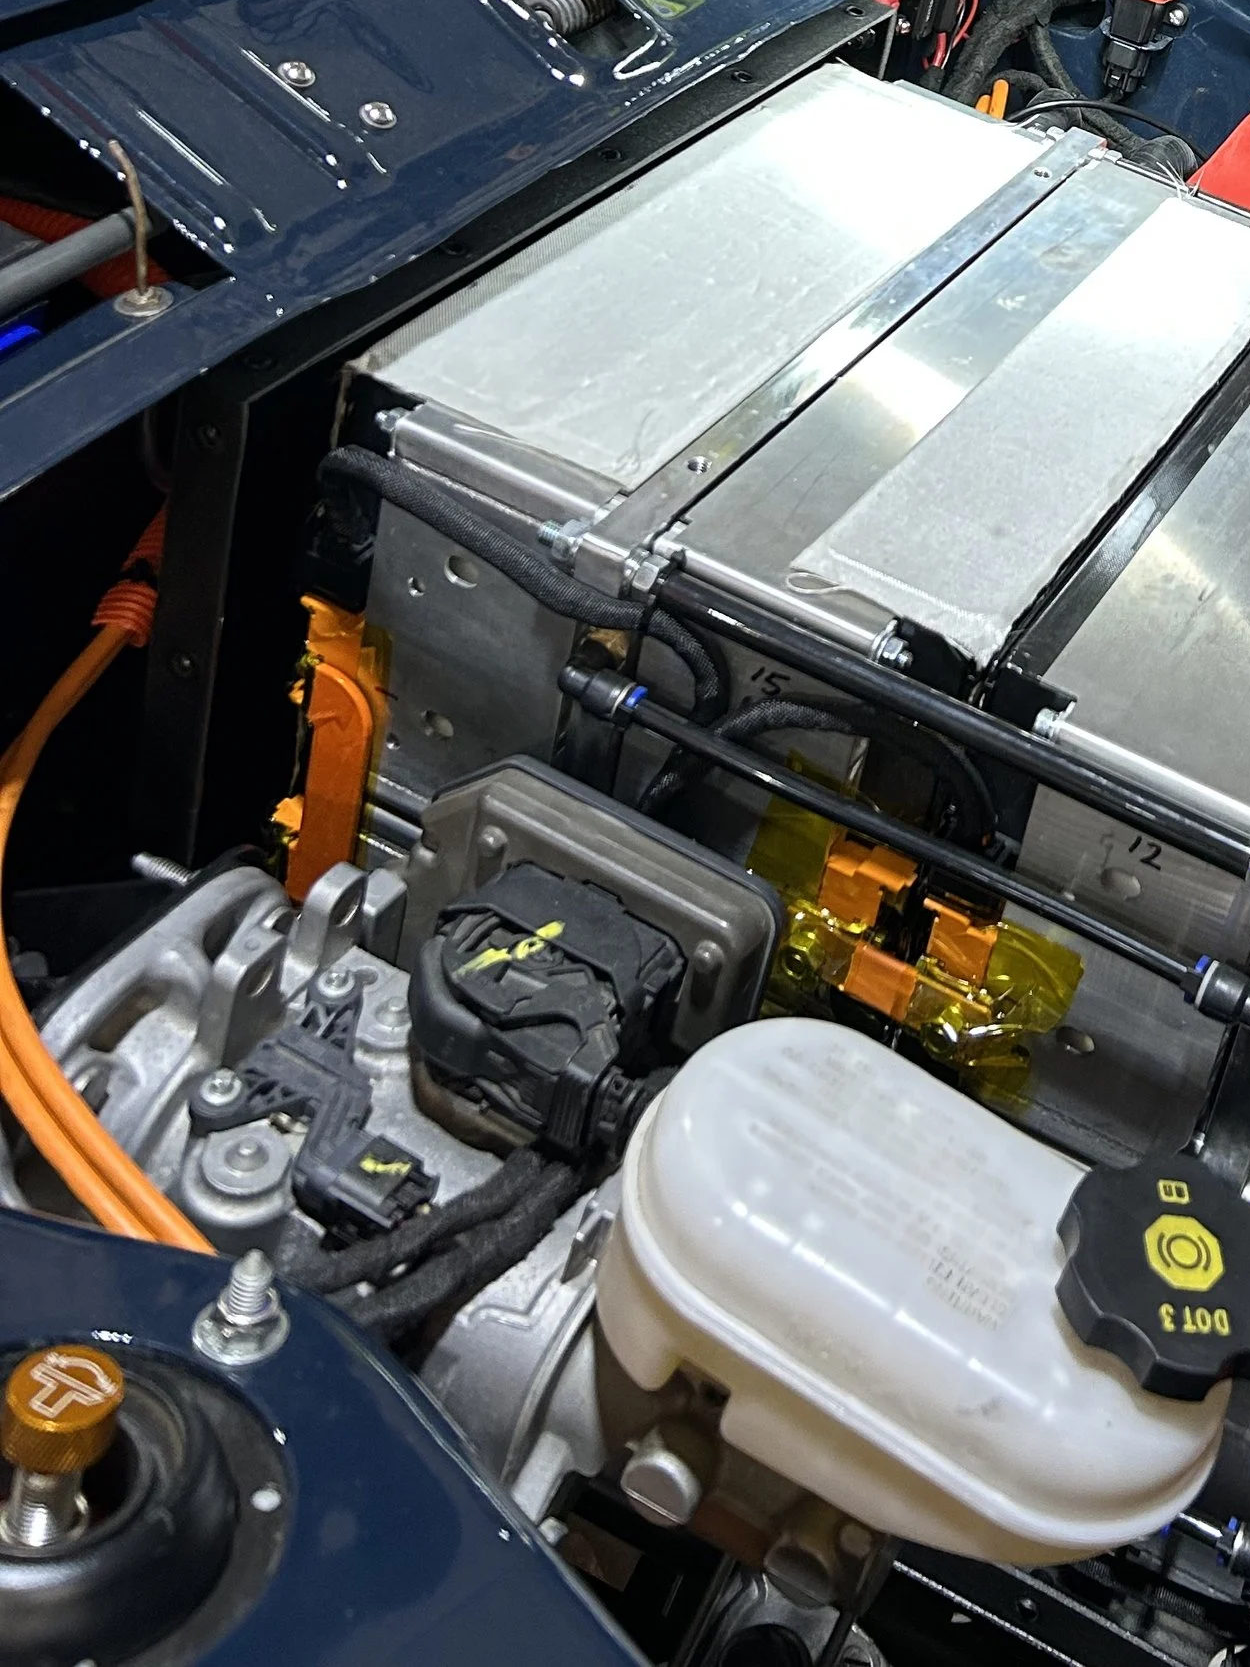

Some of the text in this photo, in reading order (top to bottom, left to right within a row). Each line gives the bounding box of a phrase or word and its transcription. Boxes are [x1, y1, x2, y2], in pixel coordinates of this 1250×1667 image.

[752, 666, 791, 695] 15
[1129, 835, 1161, 871] 12
[1159, 1302, 1232, 1336] DOT 3
